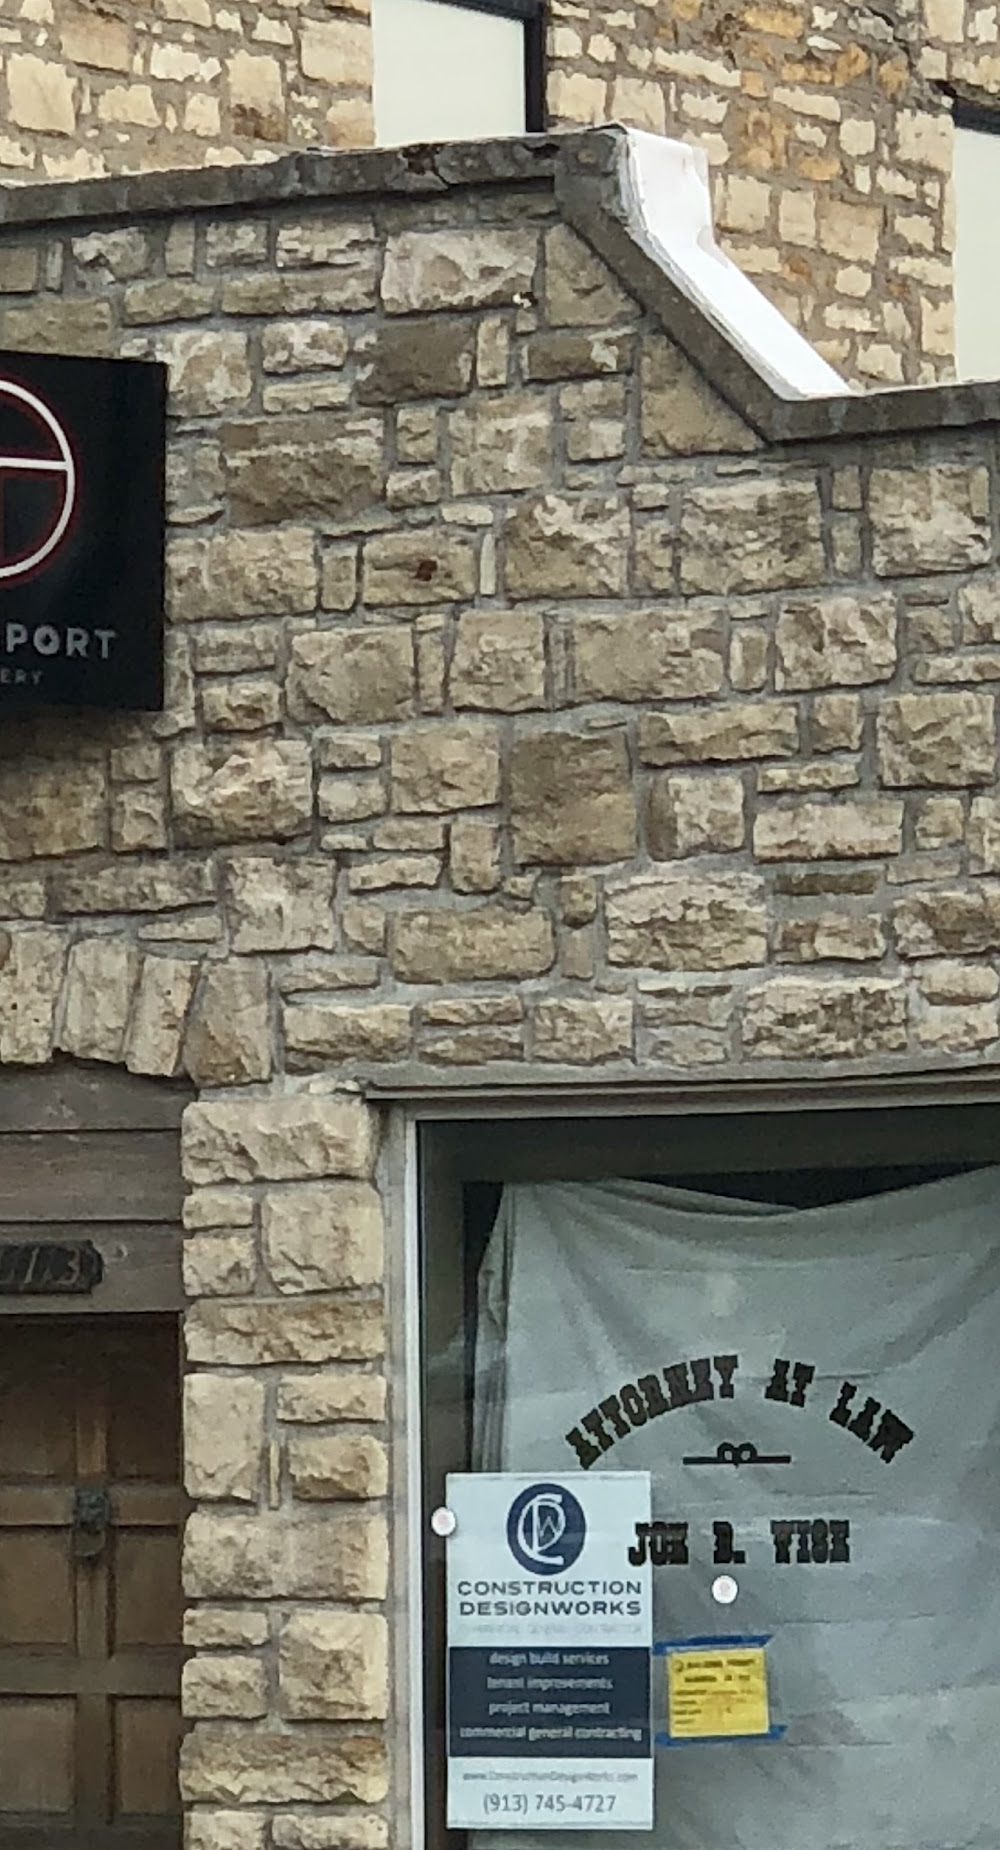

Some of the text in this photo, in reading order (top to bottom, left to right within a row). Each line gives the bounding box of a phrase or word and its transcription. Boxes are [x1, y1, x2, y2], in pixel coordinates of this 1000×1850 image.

[564, 1354, 915, 1471] ATTORNEY AT LAW
[457, 1580, 642, 1597] CONSTRUCTION
[459, 1601, 642, 1616] DESIGNWORKS
[489, 1651, 528, 1667] design
[562, 1651, 610, 1666] services
[483, 1793, 617, 1815] (913) 745-4727
